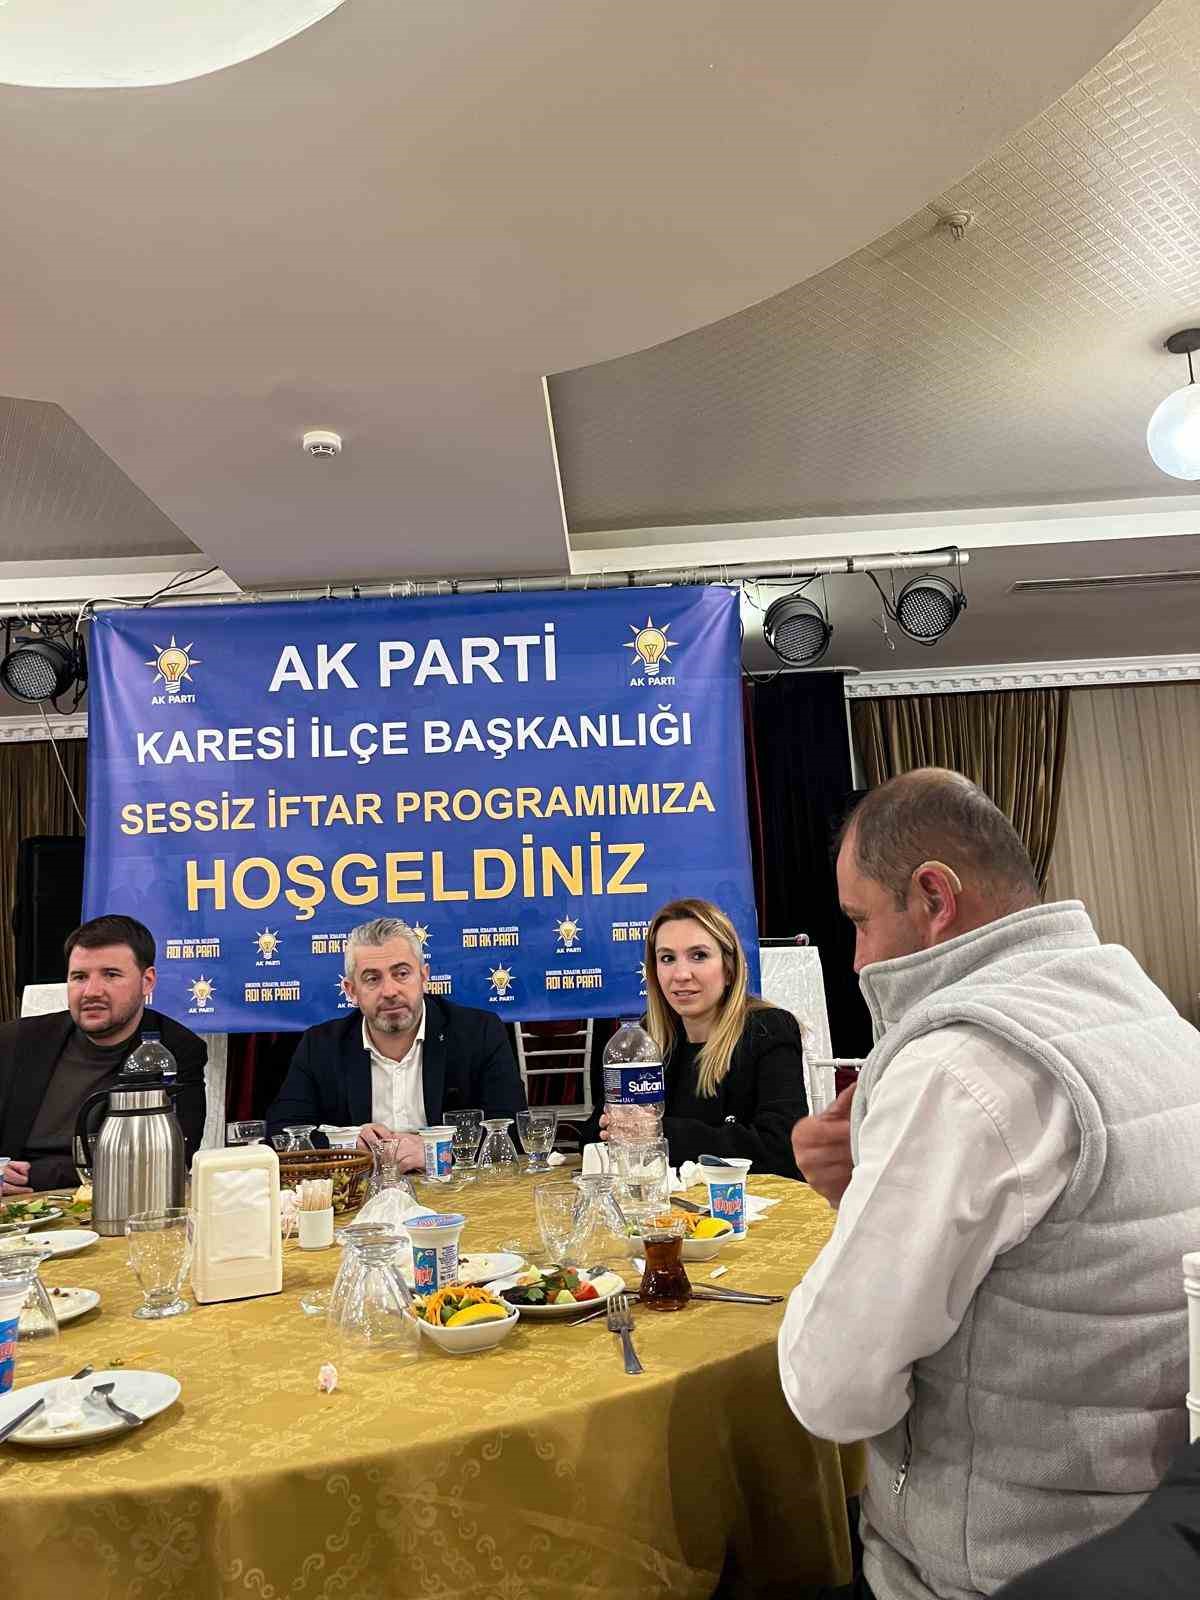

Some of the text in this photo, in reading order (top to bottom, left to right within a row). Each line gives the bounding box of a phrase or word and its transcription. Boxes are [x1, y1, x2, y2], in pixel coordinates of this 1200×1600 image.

[269, 623, 556, 692] AK PARTİ
[630, 678, 645, 687] AK
[152, 696, 166, 705] AK
[137, 703, 692, 765] KARESİ İLÇE BAŞKANLIĞI
[120, 781, 715, 835] SESSİZ İFTAR PROGRAMIMIZA
[186, 832, 648, 920] HOŞGELDİNİZ
[463, 935, 477, 948] ADI
[479, 934, 491, 947] AK
[612, 928, 627, 941] ADI
[629, 927, 641, 941] AK
[166, 946, 180, 959] ADI
[183, 945, 194, 958] AK
[312, 941, 327, 954] ADI
[329, 940, 341, 953] AK
[546, 976, 560, 990] ADI
[562, 976, 574, 989] AK
[245, 988, 259, 1002] ADI
[261, 988, 273, 1001] AK
[628, 1080, 662, 1093] Sultan
